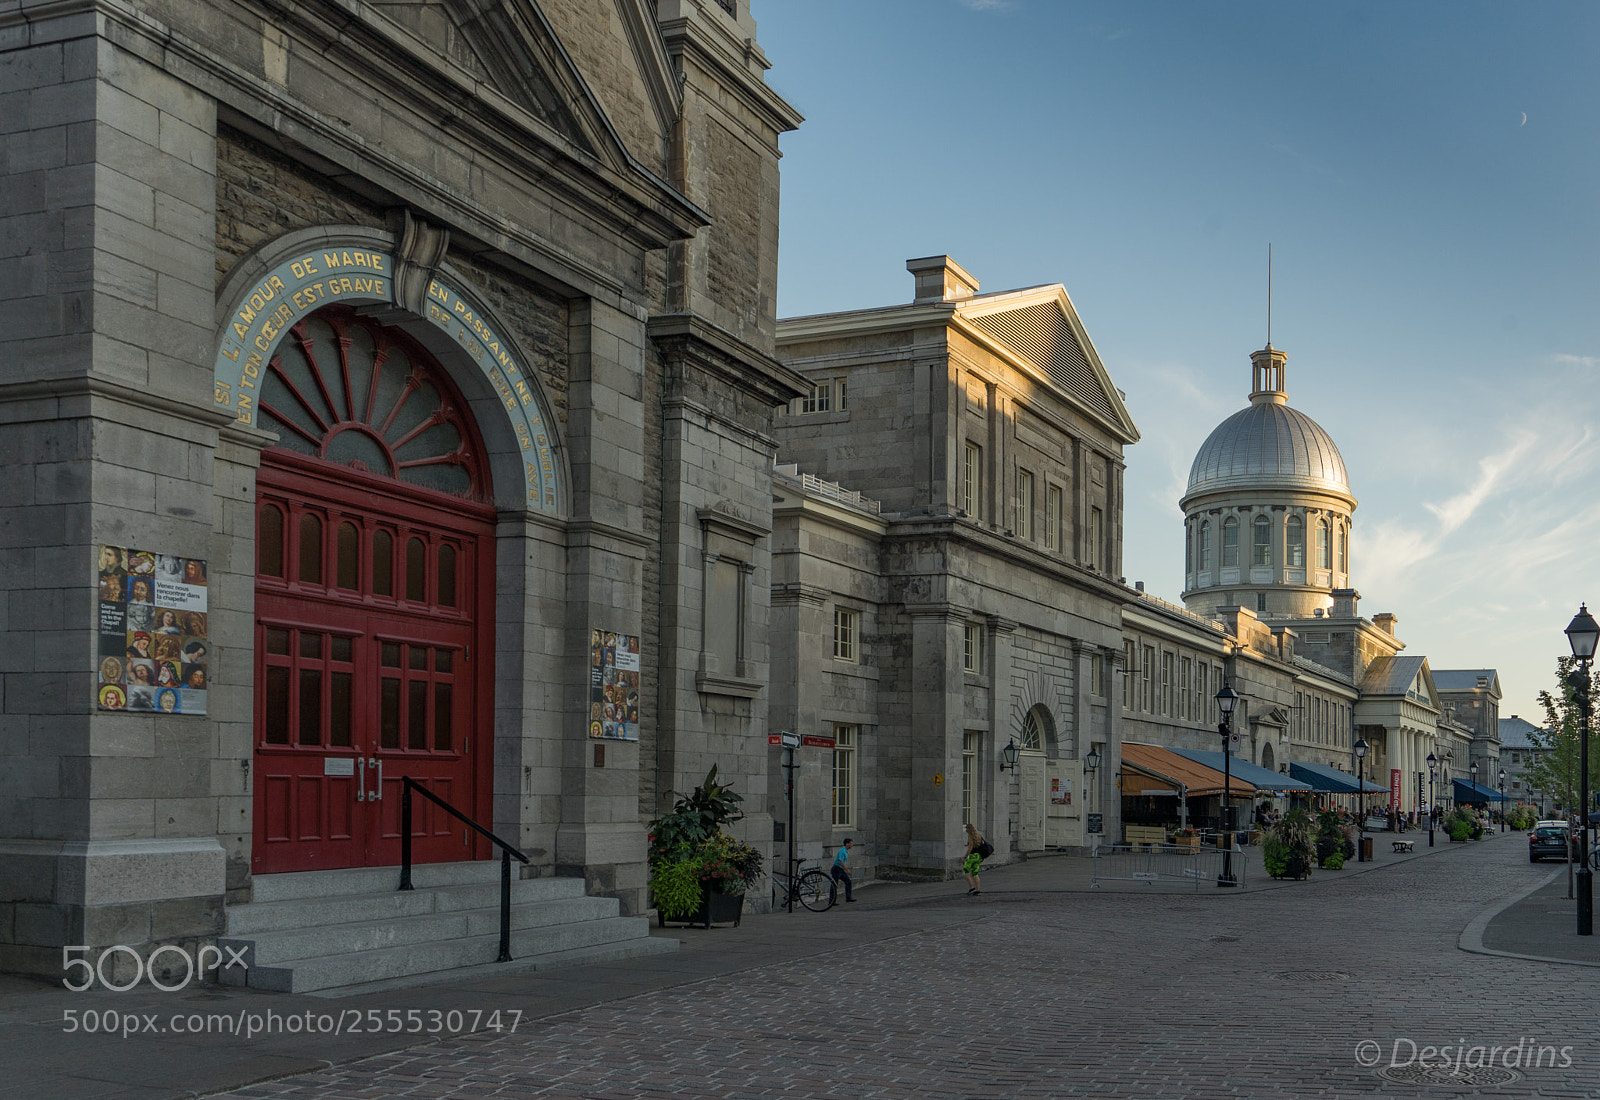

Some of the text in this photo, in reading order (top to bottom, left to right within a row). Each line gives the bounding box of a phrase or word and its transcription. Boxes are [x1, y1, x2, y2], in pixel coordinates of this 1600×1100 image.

[215, 251, 384, 406] SI L'AMOUR DE MARIE
[237, 277, 386, 424] EN TON CŒUR EST GRAVE
[429, 280, 449, 303] EN
[454, 300, 517, 375] PASSANT
[515, 380, 532, 407] NE
[430, 304, 540, 502] DE LUI DIRE UN AVE
[157, 581, 174, 590] Venez
